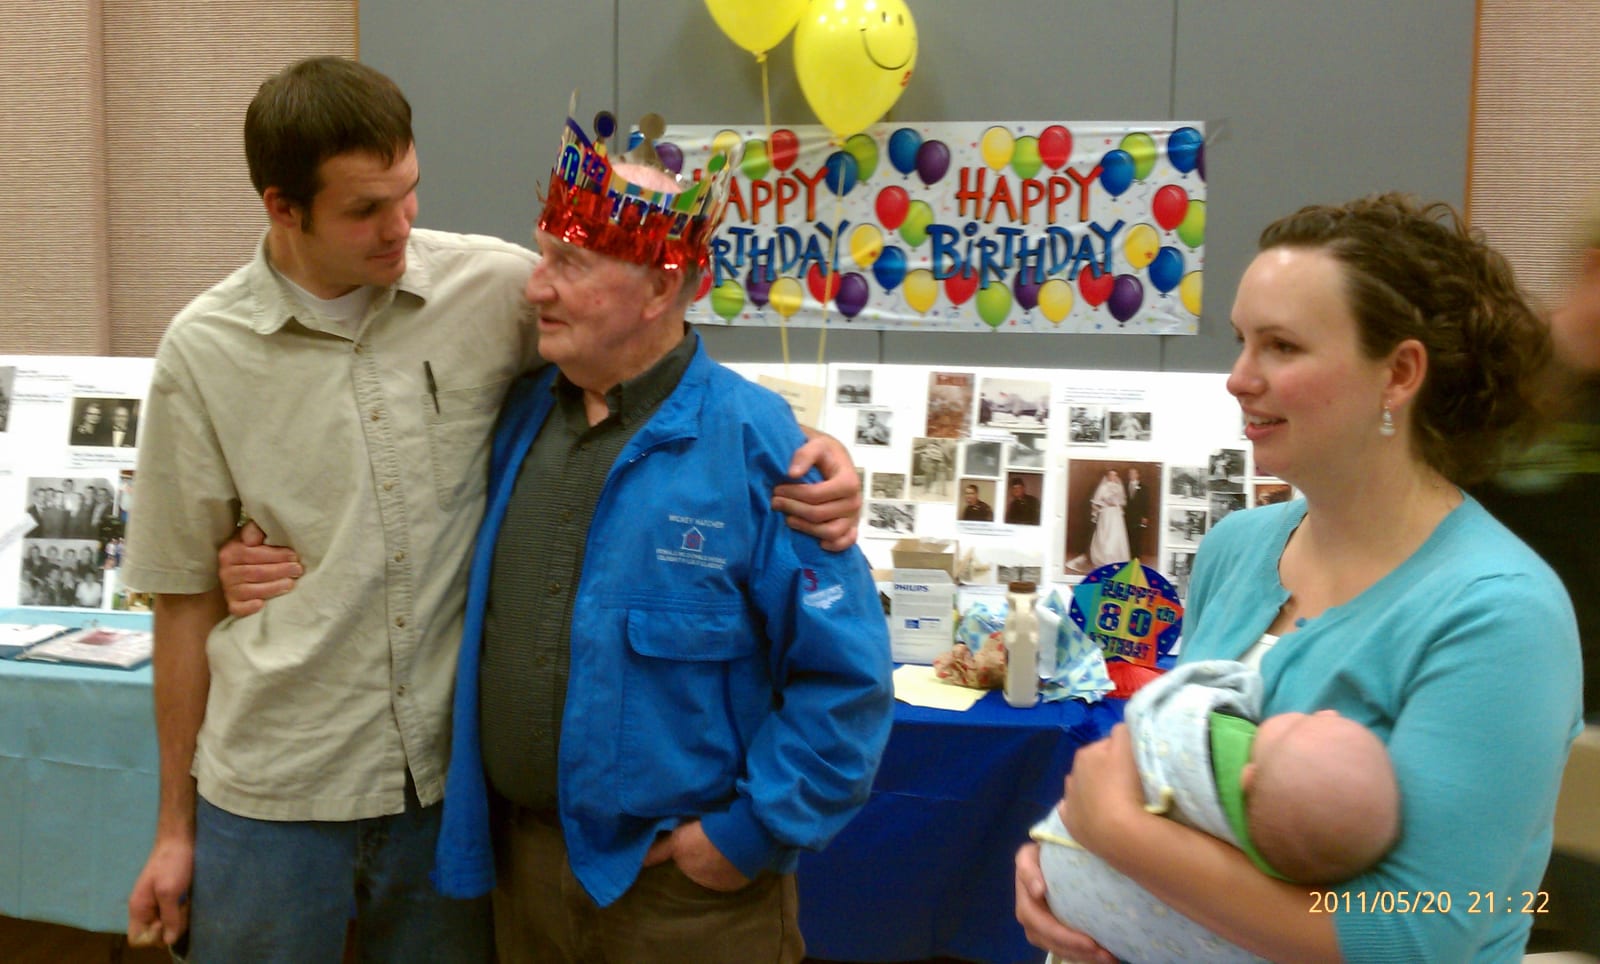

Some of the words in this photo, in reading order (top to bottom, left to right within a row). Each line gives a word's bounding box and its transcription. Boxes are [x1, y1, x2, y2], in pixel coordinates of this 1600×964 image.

[693, 166, 829, 225] APPY
[955, 165, 1104, 225] HAPPY
[709, 218, 850, 288] RTHDAY
[894, 583, 929, 592] PHILIPS
